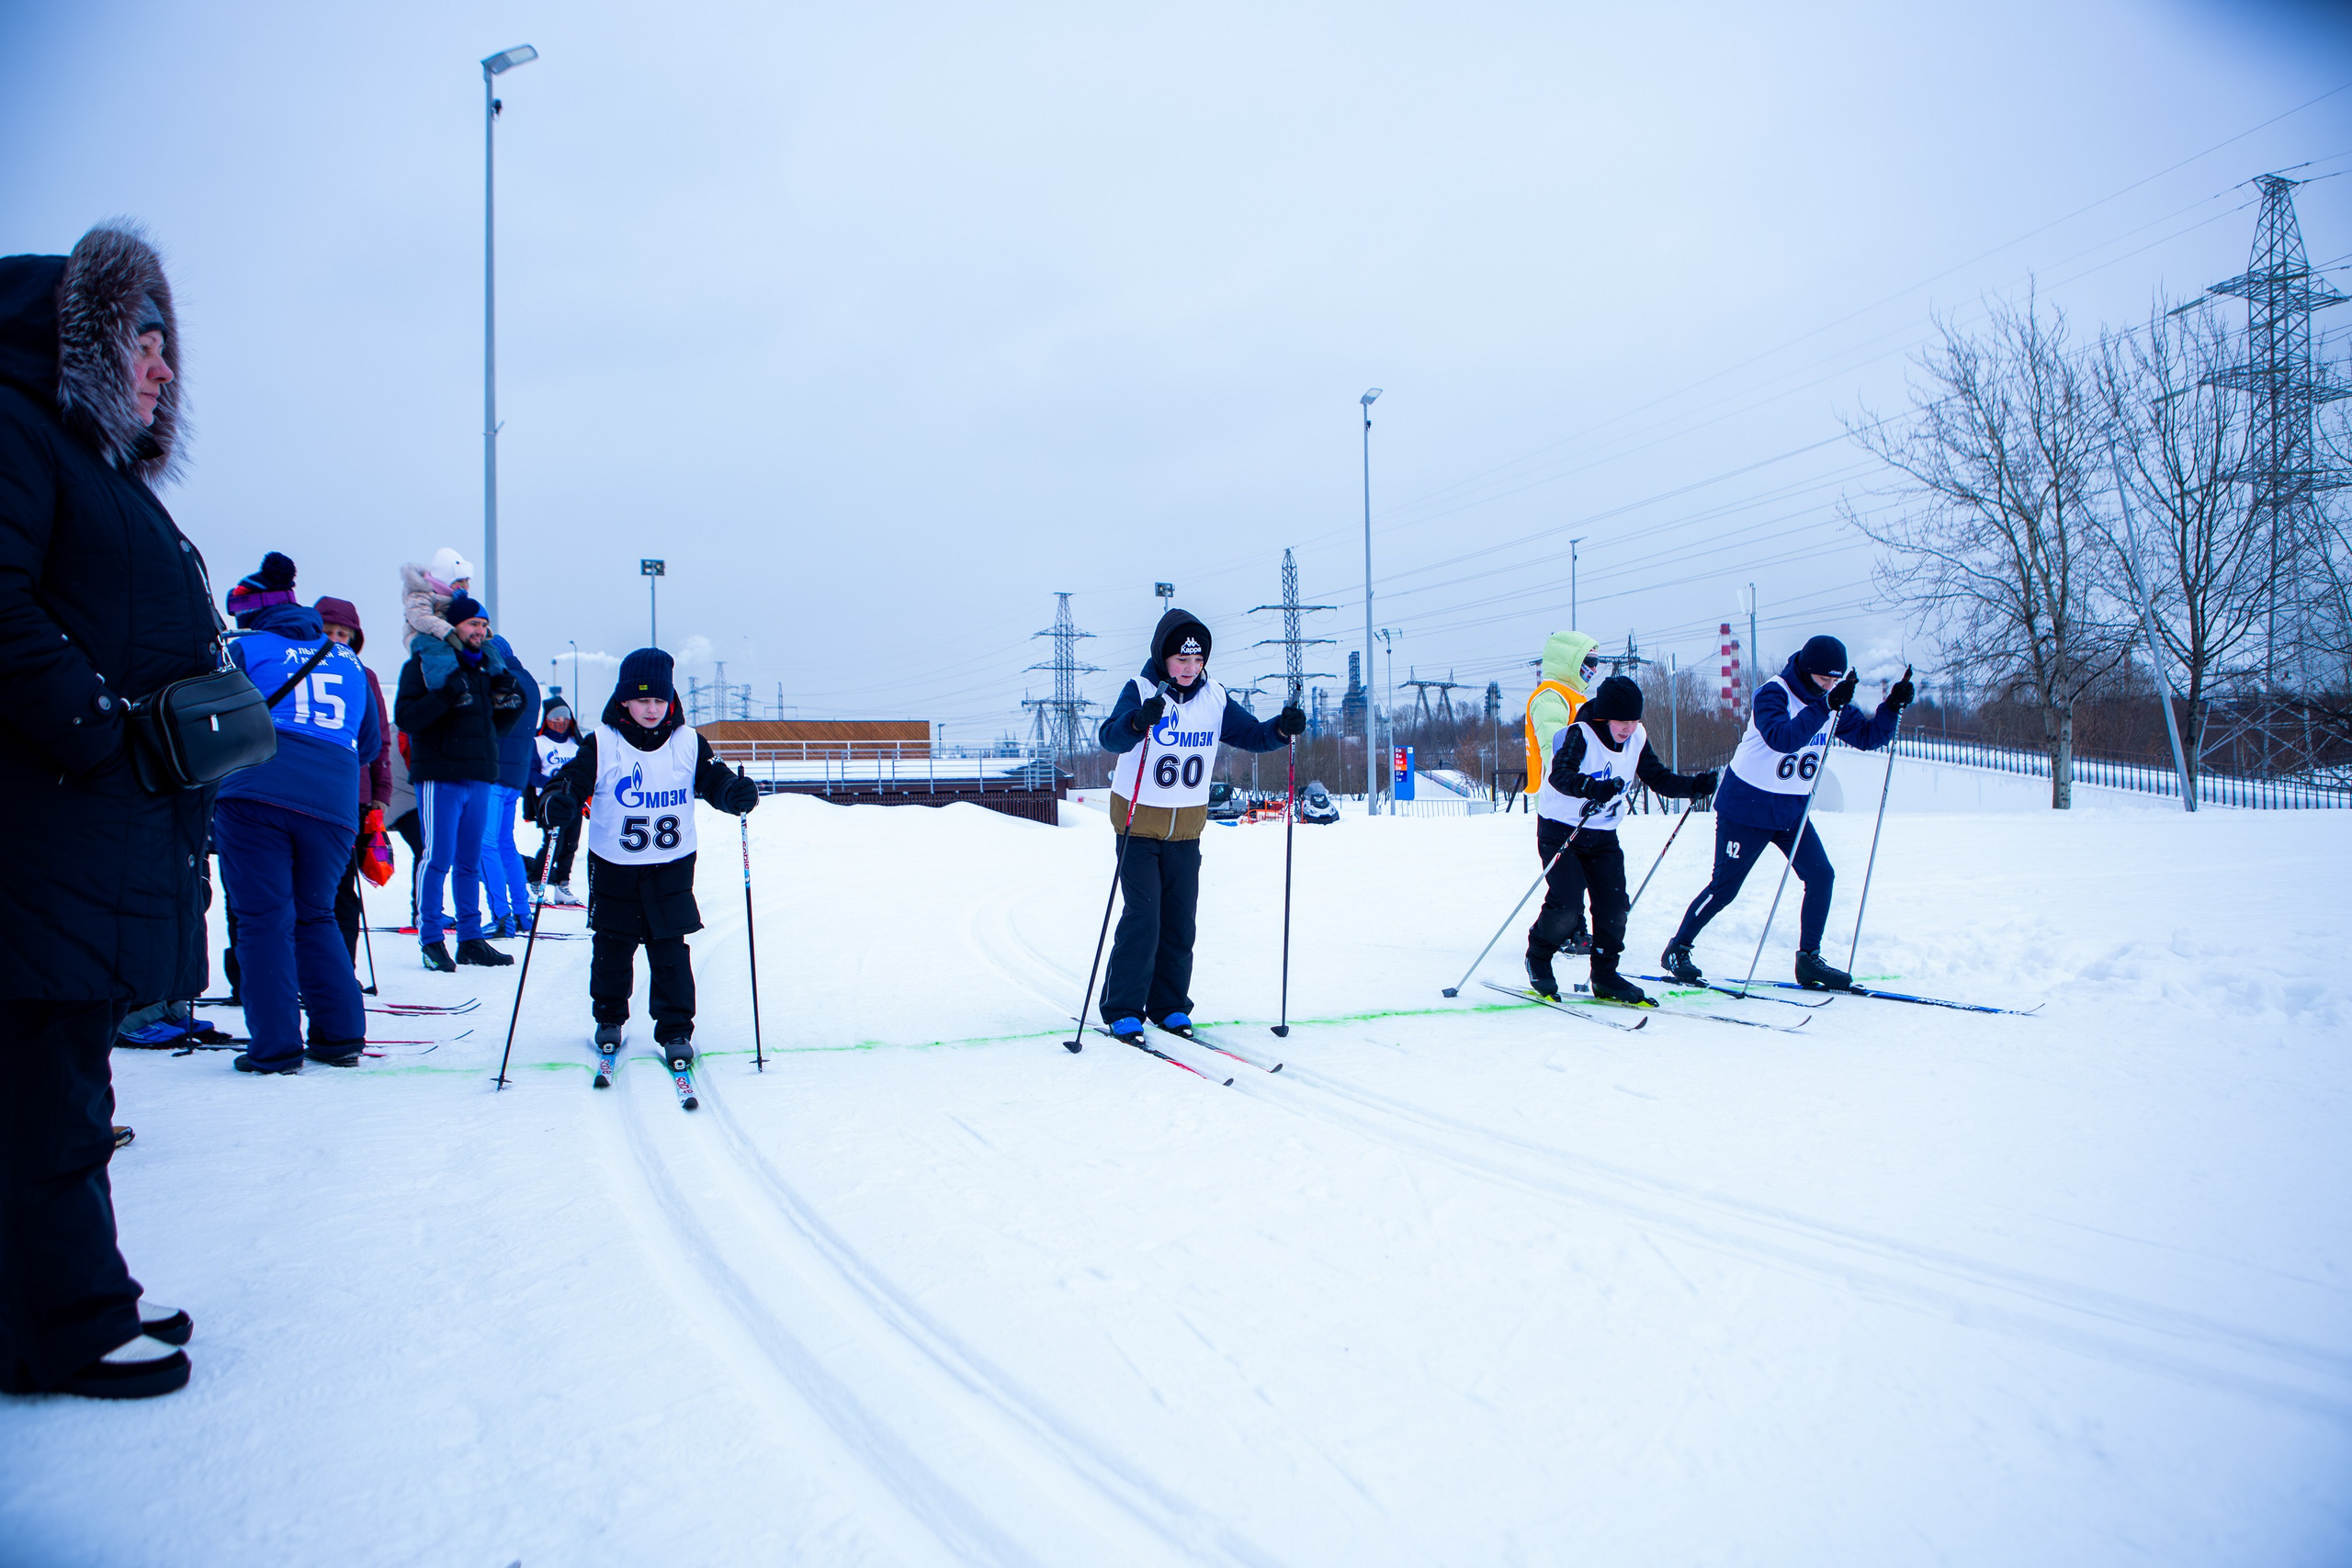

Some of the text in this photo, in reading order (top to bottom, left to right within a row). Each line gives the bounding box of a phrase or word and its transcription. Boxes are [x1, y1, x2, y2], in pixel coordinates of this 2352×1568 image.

[1181, 646, 1202, 654] Kappa
[288, 672, 345, 729] 15
[1153, 753, 1204, 789] 60
[1776, 751, 1819, 781] 66
[619, 815, 682, 852] 58
[1725, 840, 1740, 859] 42
